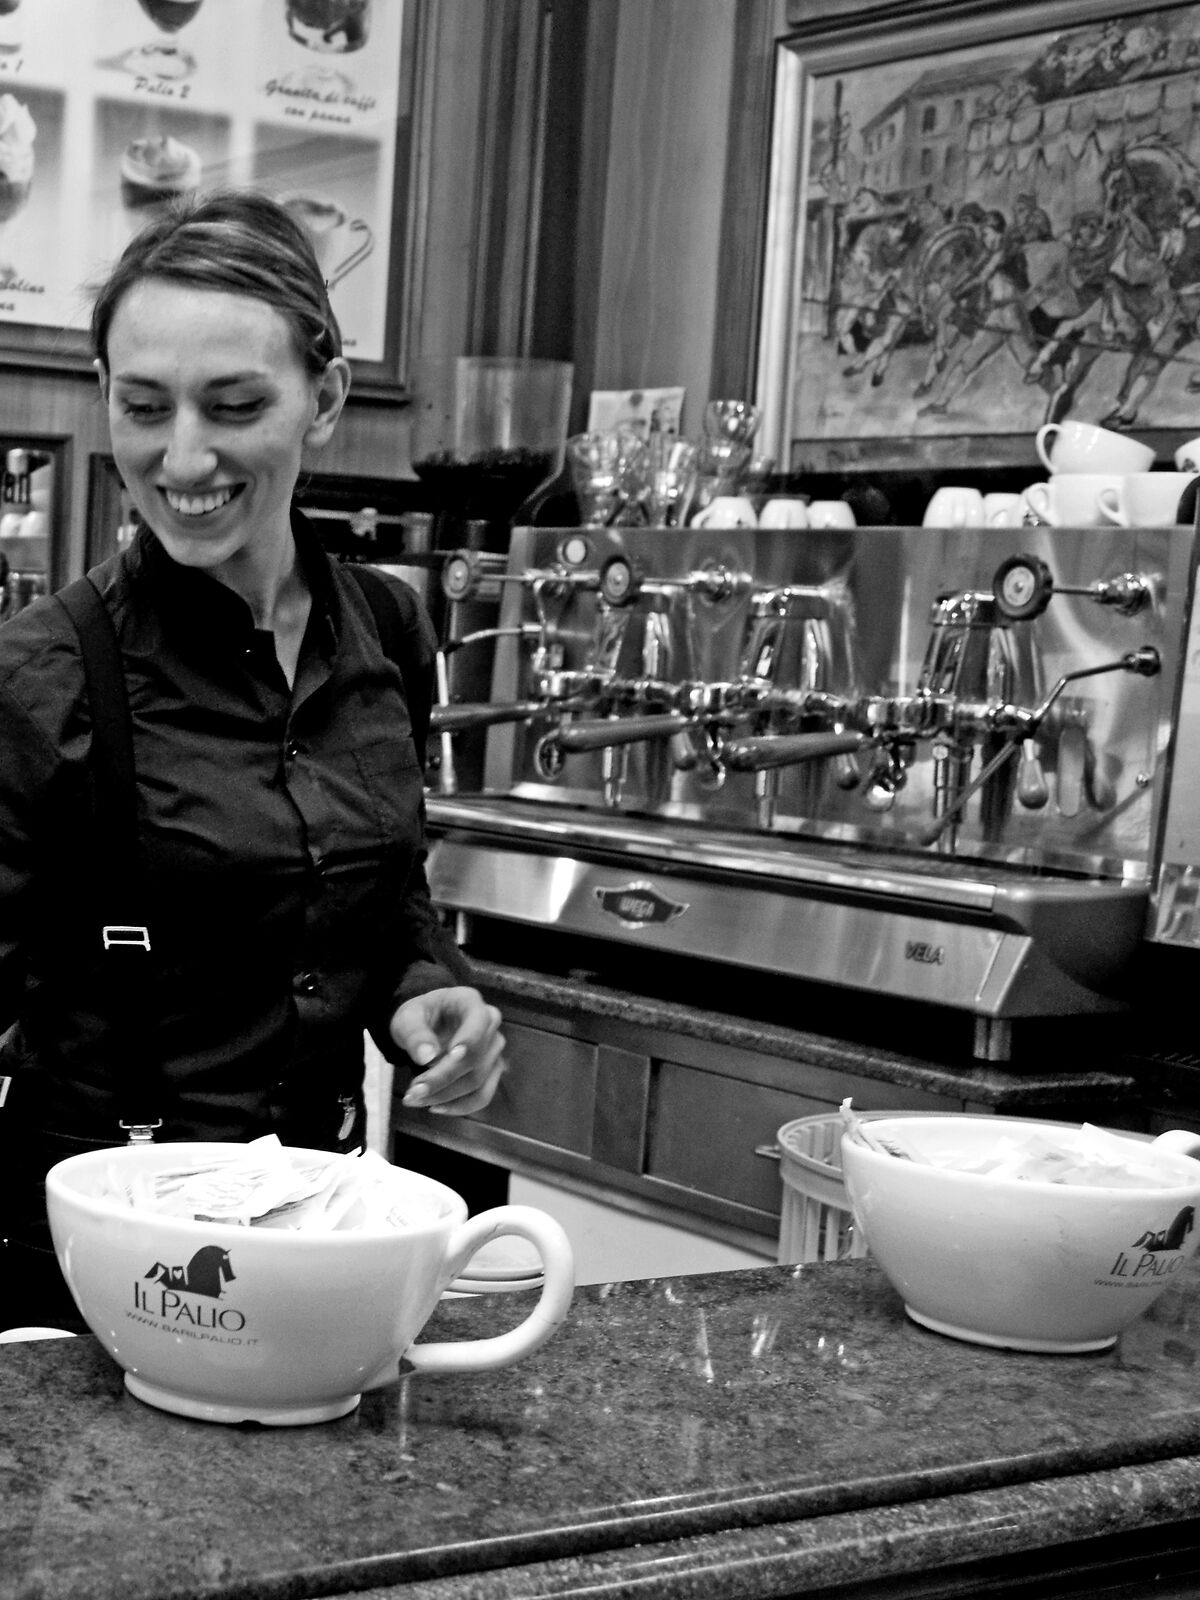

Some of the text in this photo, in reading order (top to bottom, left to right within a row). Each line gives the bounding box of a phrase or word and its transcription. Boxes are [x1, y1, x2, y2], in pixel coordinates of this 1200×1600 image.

[15, 59, 24, 73] 1
[134, 76, 191, 99] Palio 2
[1110, 1252, 1129, 1277] IL
[134, 1281, 246, 1332] IL PALIO
